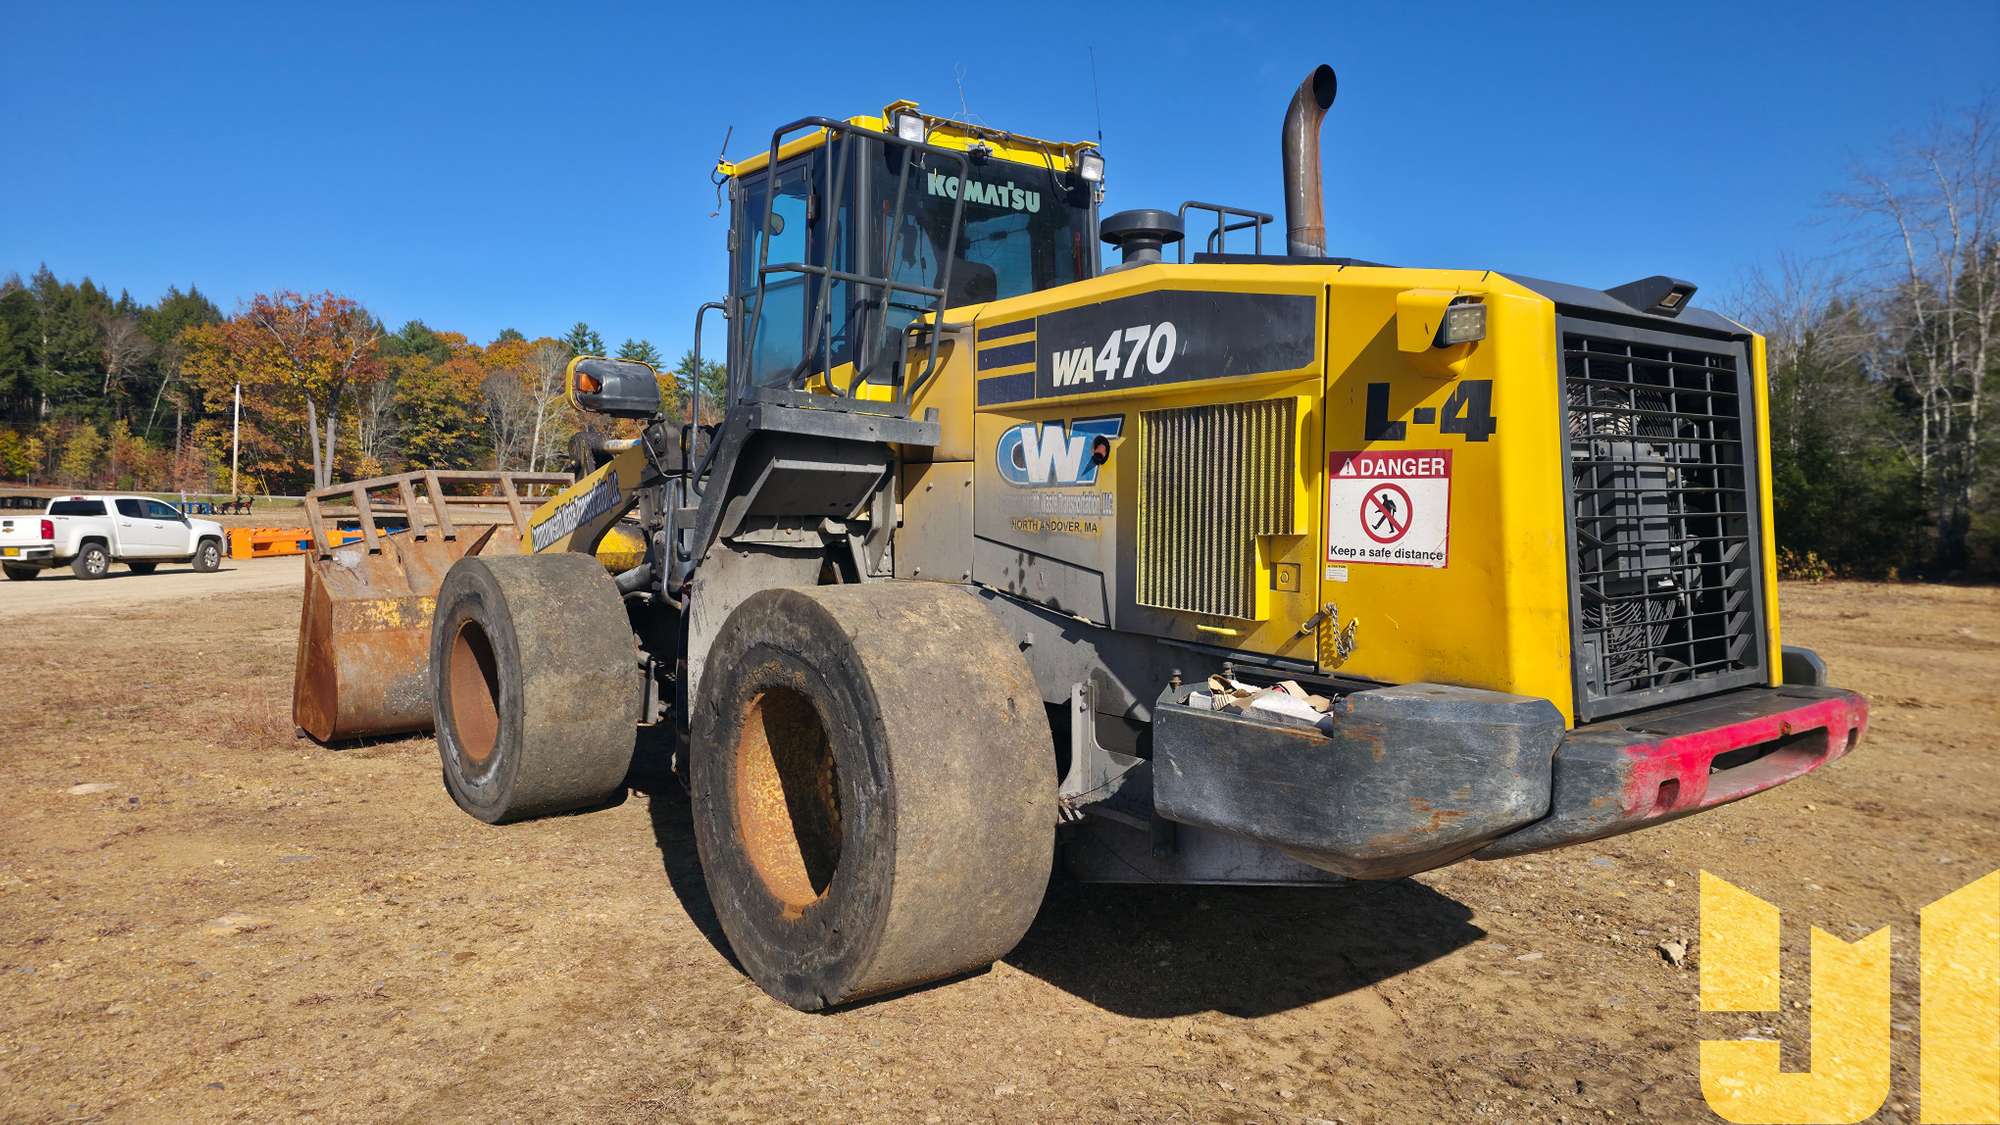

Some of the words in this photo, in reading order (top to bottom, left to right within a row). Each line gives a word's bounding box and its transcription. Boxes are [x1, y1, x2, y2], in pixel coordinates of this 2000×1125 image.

[927, 172, 1041, 213] KOMATSU
[1052, 321, 1177, 388] WA470
[1364, 379, 1497, 442] L-4
[1360, 457, 1445, 476] DANGER
[1084, 522, 1098, 532] MA
[1330, 545, 1357, 558] Keep
[1359, 549, 1366, 557] a
[1368, 548, 1391, 558] safe
[1394, 548, 1444, 561] distance
